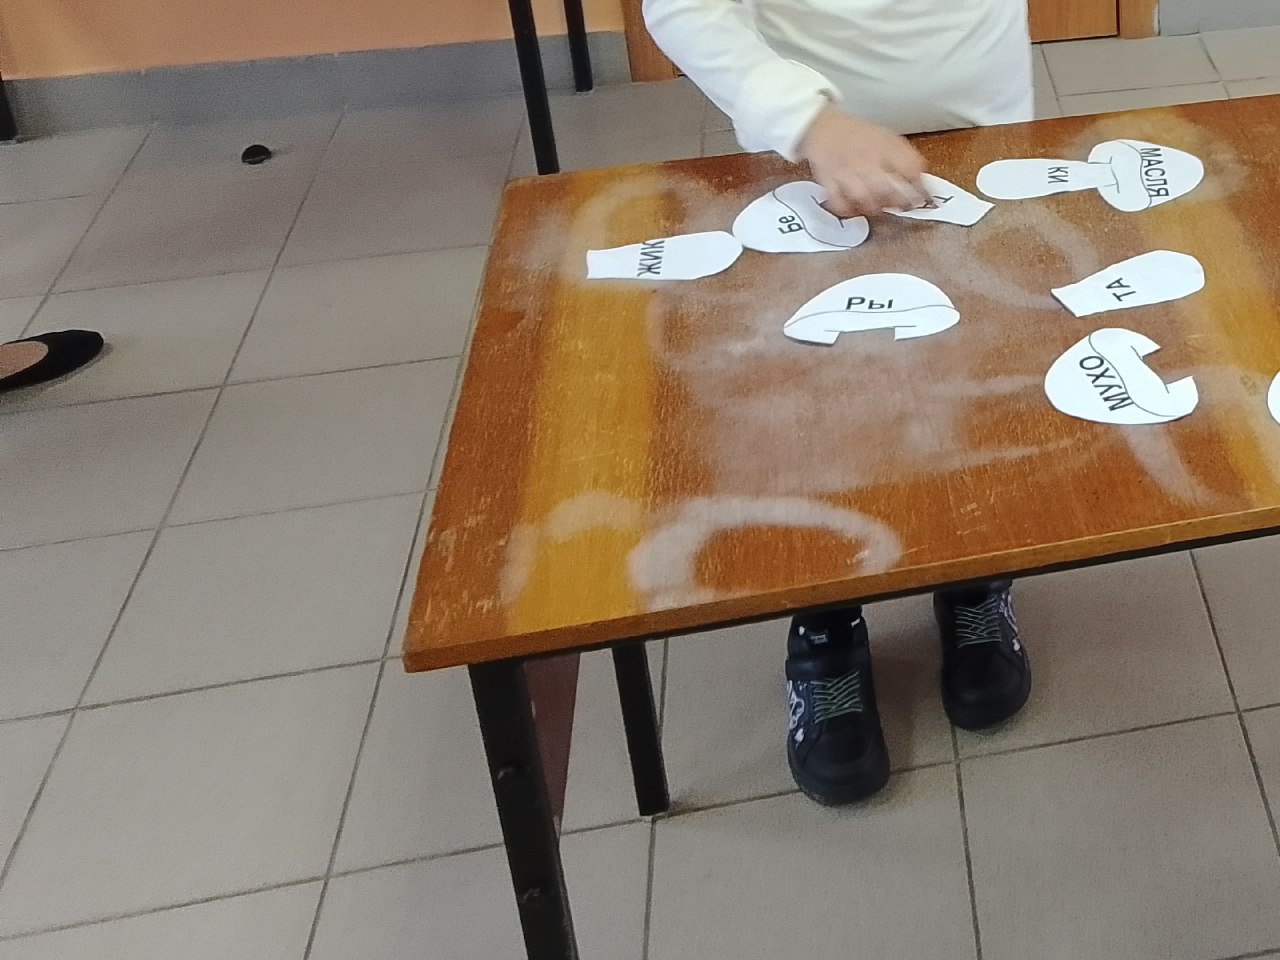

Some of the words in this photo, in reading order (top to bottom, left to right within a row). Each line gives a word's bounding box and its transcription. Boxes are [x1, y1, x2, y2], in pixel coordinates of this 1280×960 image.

[1046, 166, 1069, 184] КИ
[1139, 147, 1170, 198] МАСЛЯ
[1104, 276, 1137, 303] ТА
[1078, 355, 1135, 412] МУХО
